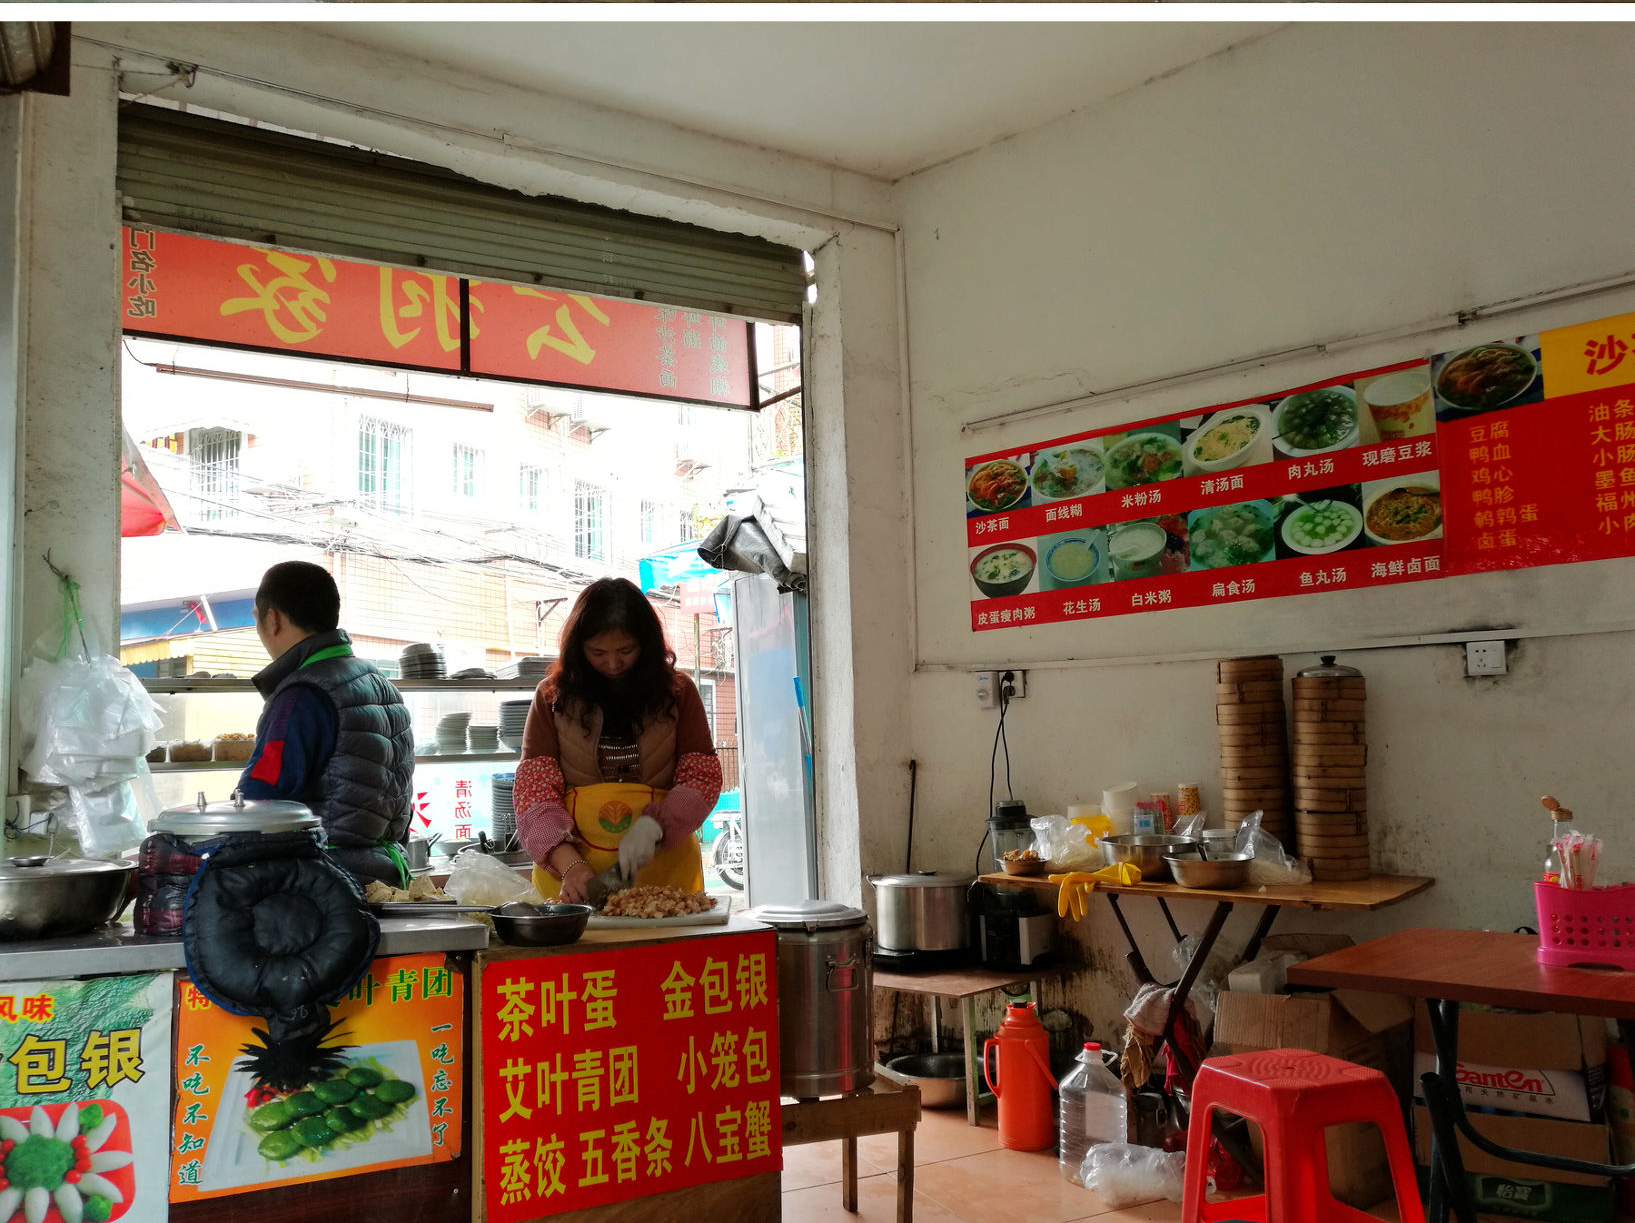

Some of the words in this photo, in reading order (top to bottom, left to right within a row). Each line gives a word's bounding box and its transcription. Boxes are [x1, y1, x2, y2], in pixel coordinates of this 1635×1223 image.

[1584, 333, 1635, 376] 沙
[1588, 399, 1635, 423] 油条
[1468, 420, 1511, 444] 豆腐
[1591, 422, 1635, 445] 大肠
[1469, 444, 1512, 465] 鸭血
[1592, 445, 1635, 467] 小肠
[975, 515, 1010, 535] 沙茶面
[1045, 502, 1084, 522] 面线糊
[1120, 488, 1163, 509] 米粉汤
[1200, 474, 1244, 496] 清汤面
[1288, 457, 1334, 481] 肉丸汤
[1362, 441, 1433, 467] 现磨豆浆
[1471, 467, 1514, 485] 鸡心
[1472, 487, 1515, 507] 鸭胗
[1473, 503, 1539, 529] 鹌鹑蛋
[1477, 528, 1518, 550] 卤蛋
[977, 606, 1036, 626] 皮蛋瘦肉粥
[1063, 598, 1101, 615] 花生汤
[1131, 589, 1172, 607] 白米粥
[1211, 579, 1256, 598] 扁食汤
[1299, 567, 1347, 587] 鱼丸汤
[1371, 555, 1441, 578] 海鲜卤面
[329, 967, 453, 1008] 叶青团
[496, 969, 618, 1042] 茶叶蛋
[660, 953, 768, 1022] 金包银
[431, 1022, 455, 1147] 一吃忘不了
[498, 1045, 640, 1123] 艾叶青团
[678, 1027, 771, 1096] 小笼包
[177, 1045, 210, 1186] 不吃不知道
[499, 1134, 567, 1205] 蒸饺
[578, 1118, 673, 1189] 五香条
[685, 1100, 773, 1168] 八宝蟹
